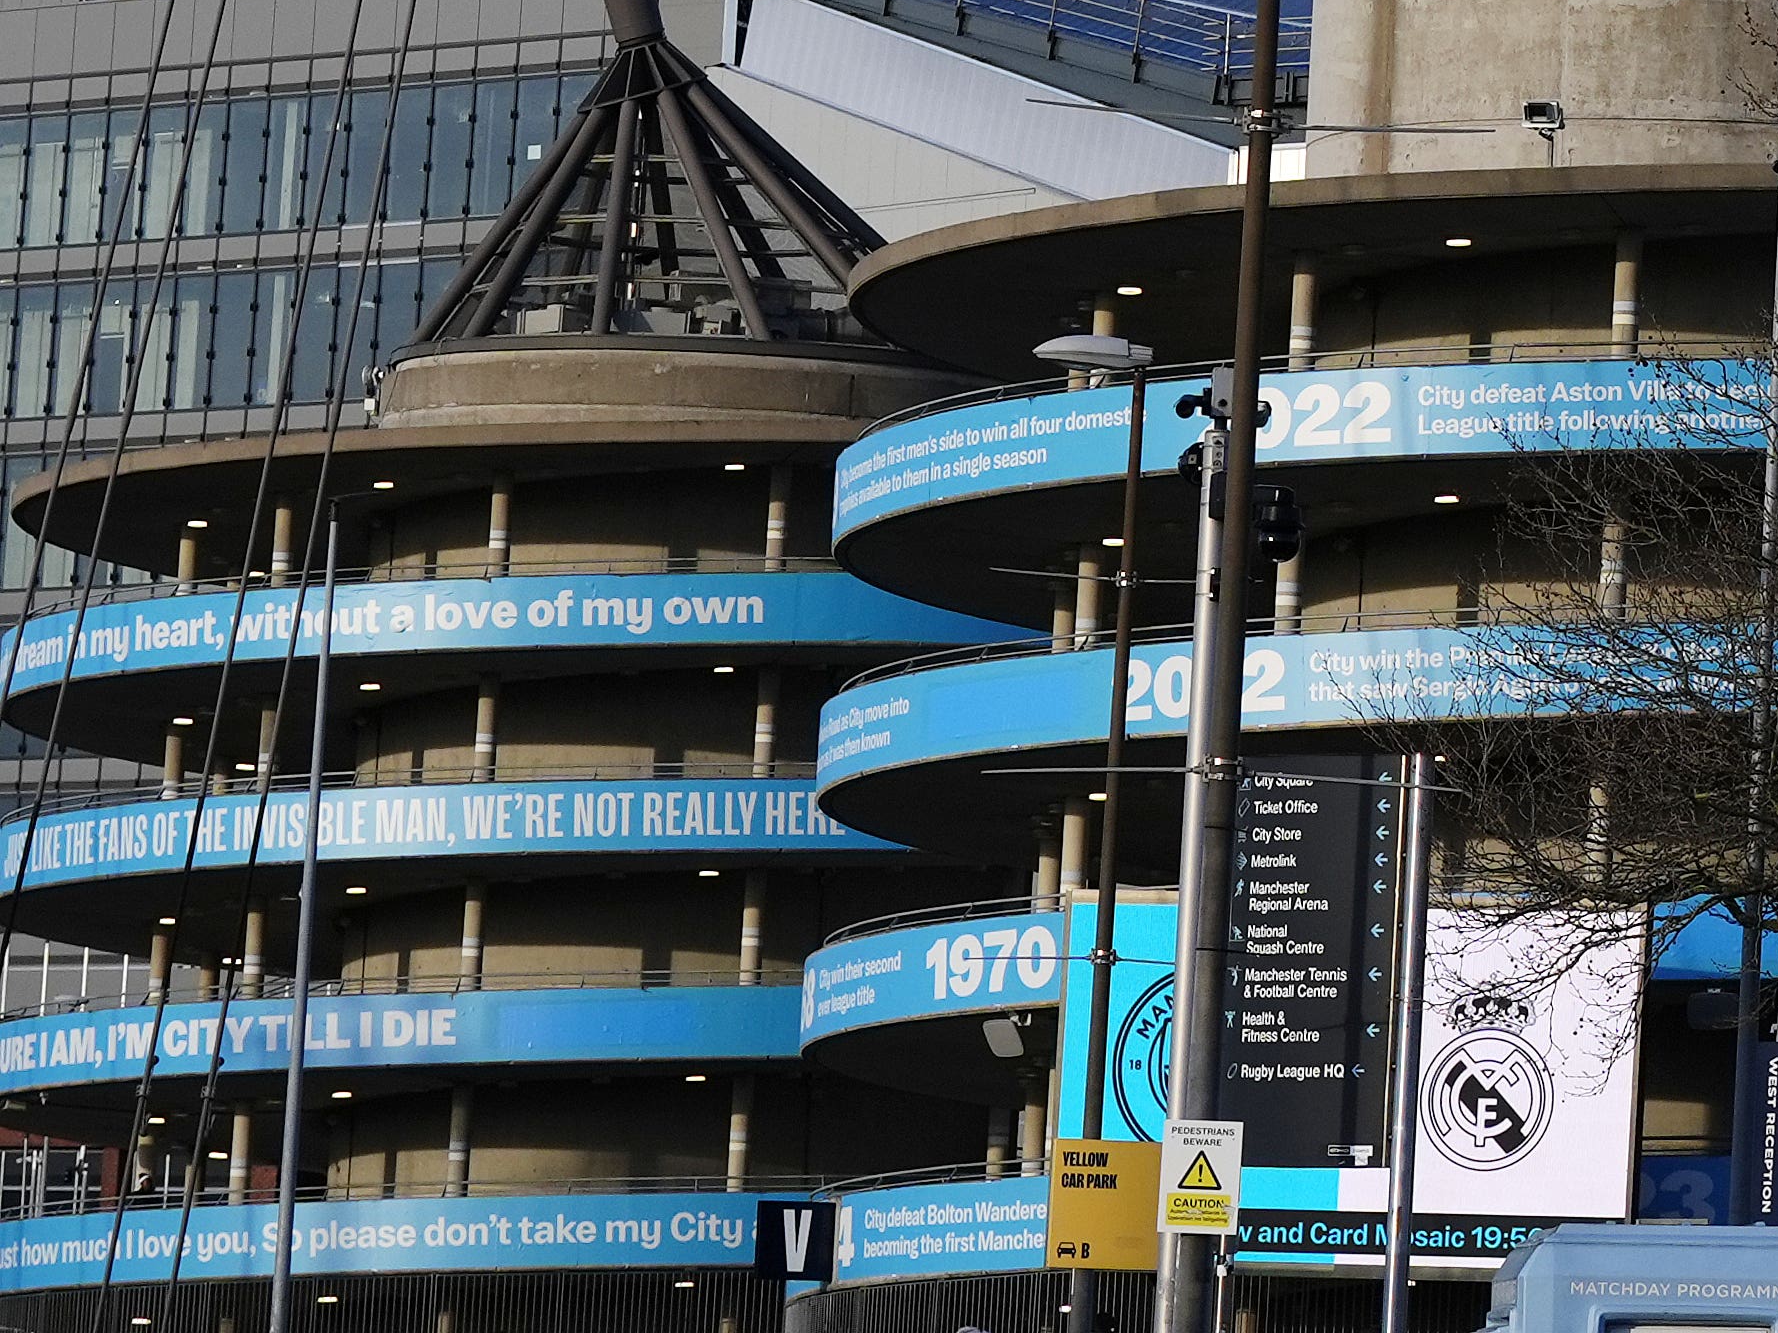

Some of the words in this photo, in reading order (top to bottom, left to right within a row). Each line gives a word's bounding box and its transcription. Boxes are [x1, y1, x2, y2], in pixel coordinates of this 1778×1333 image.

[1417, 383, 1465, 409] City
[1470, 381, 1546, 405] defeat
[1550, 381, 1623, 403] Aston
[939, 429, 964, 452] side
[966, 427, 979, 446] to
[981, 421, 1007, 443] win
[1010, 416, 1028, 440] all
[1030, 415, 1064, 438] four
[1417, 412, 1501, 439] League
[1507, 409, 1553, 433] title
[902, 468, 930, 486] them
[930, 461, 941, 482] in
[943, 463, 951, 479] a
[953, 452, 990, 478] single
[993, 448, 1047, 470] season
[90, 625, 130, 662] my
[135, 609, 225, 651] heart,
[229, 598, 381, 644] without
[389, 603, 415, 633] a
[424, 593, 518, 631] love
[527, 589, 574, 627] of
[582, 597, 653, 634] my
[663, 595, 764, 625] own
[1309, 649, 1355, 676] City
[1359, 648, 1400, 669] win
[1405, 646, 1444, 669] the
[1309, 678, 1355, 703] that
[890, 696, 910, 717] into
[1253, 800, 1283, 814] Ticket
[1285, 799, 1318, 814] Office
[31, 824, 61, 873] LIKE
[64, 821, 95, 867] THE
[98, 813, 149, 861] FANS
[153, 812, 179, 858] OF
[183, 807, 228, 856] THE
[375, 797, 456, 848] MAN,
[462, 792, 564, 840] WE'RE
[573, 792, 634, 838] NOT
[642, 791, 758, 837] REALLY
[1252, 828, 1271, 844] City
[1275, 827, 1302, 841] Store
[1250, 853, 1297, 868] Metrolink
[1250, 881, 1309, 895] Manchester
[1249, 897, 1292, 914] Regional
[1293, 897, 1329, 911] Arena
[1247, 924, 1288, 938] National
[1246, 940, 1284, 957] Squash
[1285, 941, 1325, 955] Centre
[865, 949, 901, 977] second
[925, 925, 1057, 1000] 1970
[1244, 968, 1307, 982] Manchester
[1308, 967, 1348, 982] Tennis
[856, 984, 876, 1006] title
[1243, 985, 1252, 998] &
[1253, 984, 1294, 998] Football
[1297, 984, 1338, 998] Centre
[1242, 1010, 1275, 1026] Health
[1277, 1011, 1286, 1025] &
[50, 1027, 103, 1070] AM,
[162, 1015, 254, 1058] CITY
[359, 1011, 373, 1048] I
[382, 1008, 457, 1047] DIE
[1241, 1028, 1278, 1043] Fitness
[1280, 1027, 1320, 1043] Centre
[1129, 1059, 1142, 1071] 18
[1240, 1064, 1275, 1082] Rugby
[1276, 1063, 1321, 1081] League
[1324, 1063, 1345, 1078] HQ
[1171, 1126, 1235, 1137] PEDESTRIANS
[1183, 1137, 1222, 1147] BEWARE
[1062, 1151, 1109, 1168] YELLOW
[1761, 1112, 1776, 1214] RECEPTION
[1061, 1173, 1085, 1189] CAR
[1087, 1174, 1118, 1190] PARK
[1173, 1197, 1224, 1209] CAUTION
[864, 1208, 886, 1232] City
[887, 1206, 926, 1228] defeat
[927, 1203, 973, 1226] Bolton
[21, 1234, 63, 1267] how
[62, 1228, 122, 1264] much
[138, 1228, 192, 1259] love
[197, 1230, 257, 1264] you,
[309, 1220, 417, 1258] please
[428, 1214, 511, 1247] don't
[518, 1213, 597, 1244] take
[605, 1219, 661, 1250] my
[670, 1212, 743, 1249] City
[783, 1208, 812, 1273] V
[1257, 1222, 1303, 1244] and
[1309, 1222, 1369, 1246] Card
[863, 1235, 919, 1259] becoming
[920, 1233, 942, 1255] the
[944, 1231, 975, 1254] first
[1080, 1241, 1090, 1259] B
[1569, 1281, 1672, 1298] MATCHDAY
